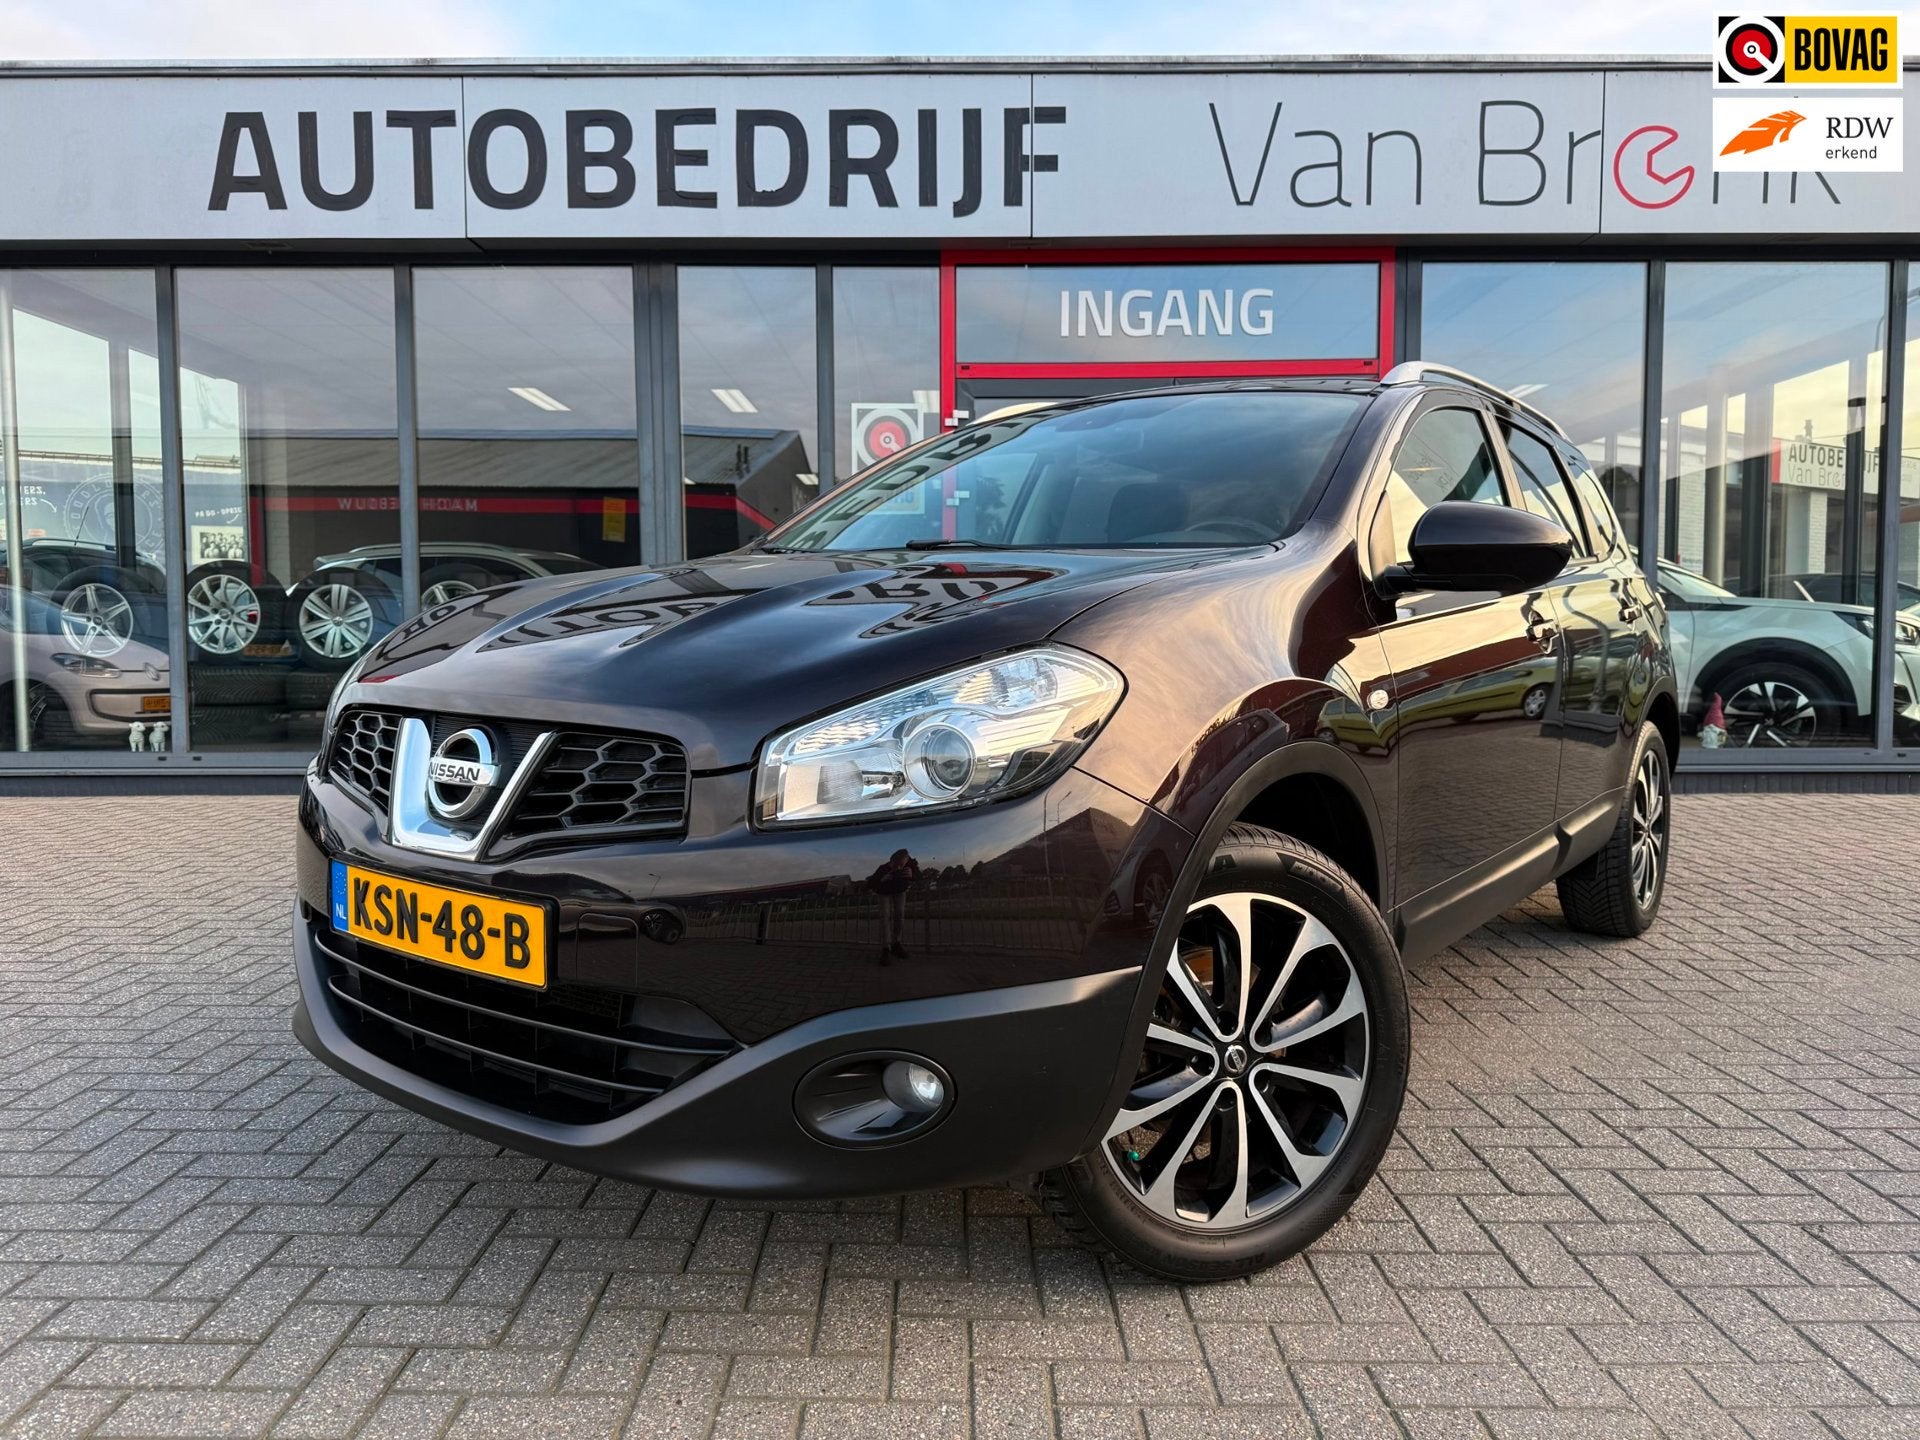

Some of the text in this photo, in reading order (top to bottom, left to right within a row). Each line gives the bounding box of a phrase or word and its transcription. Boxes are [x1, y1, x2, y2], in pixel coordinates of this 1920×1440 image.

[208, 106, 1067, 218] AUTOBEDRIJF
[1208, 100, 1424, 208] Van
[1060, 288, 1274, 338] INGANG
[1787, 463, 1813, 484] Van
[1788, 443, 1880, 474] AUTOBEJF
[429, 761, 480, 781] NISSAN
[335, 902, 347, 920] NL
[353, 876, 531, 970] KSN-48-B
